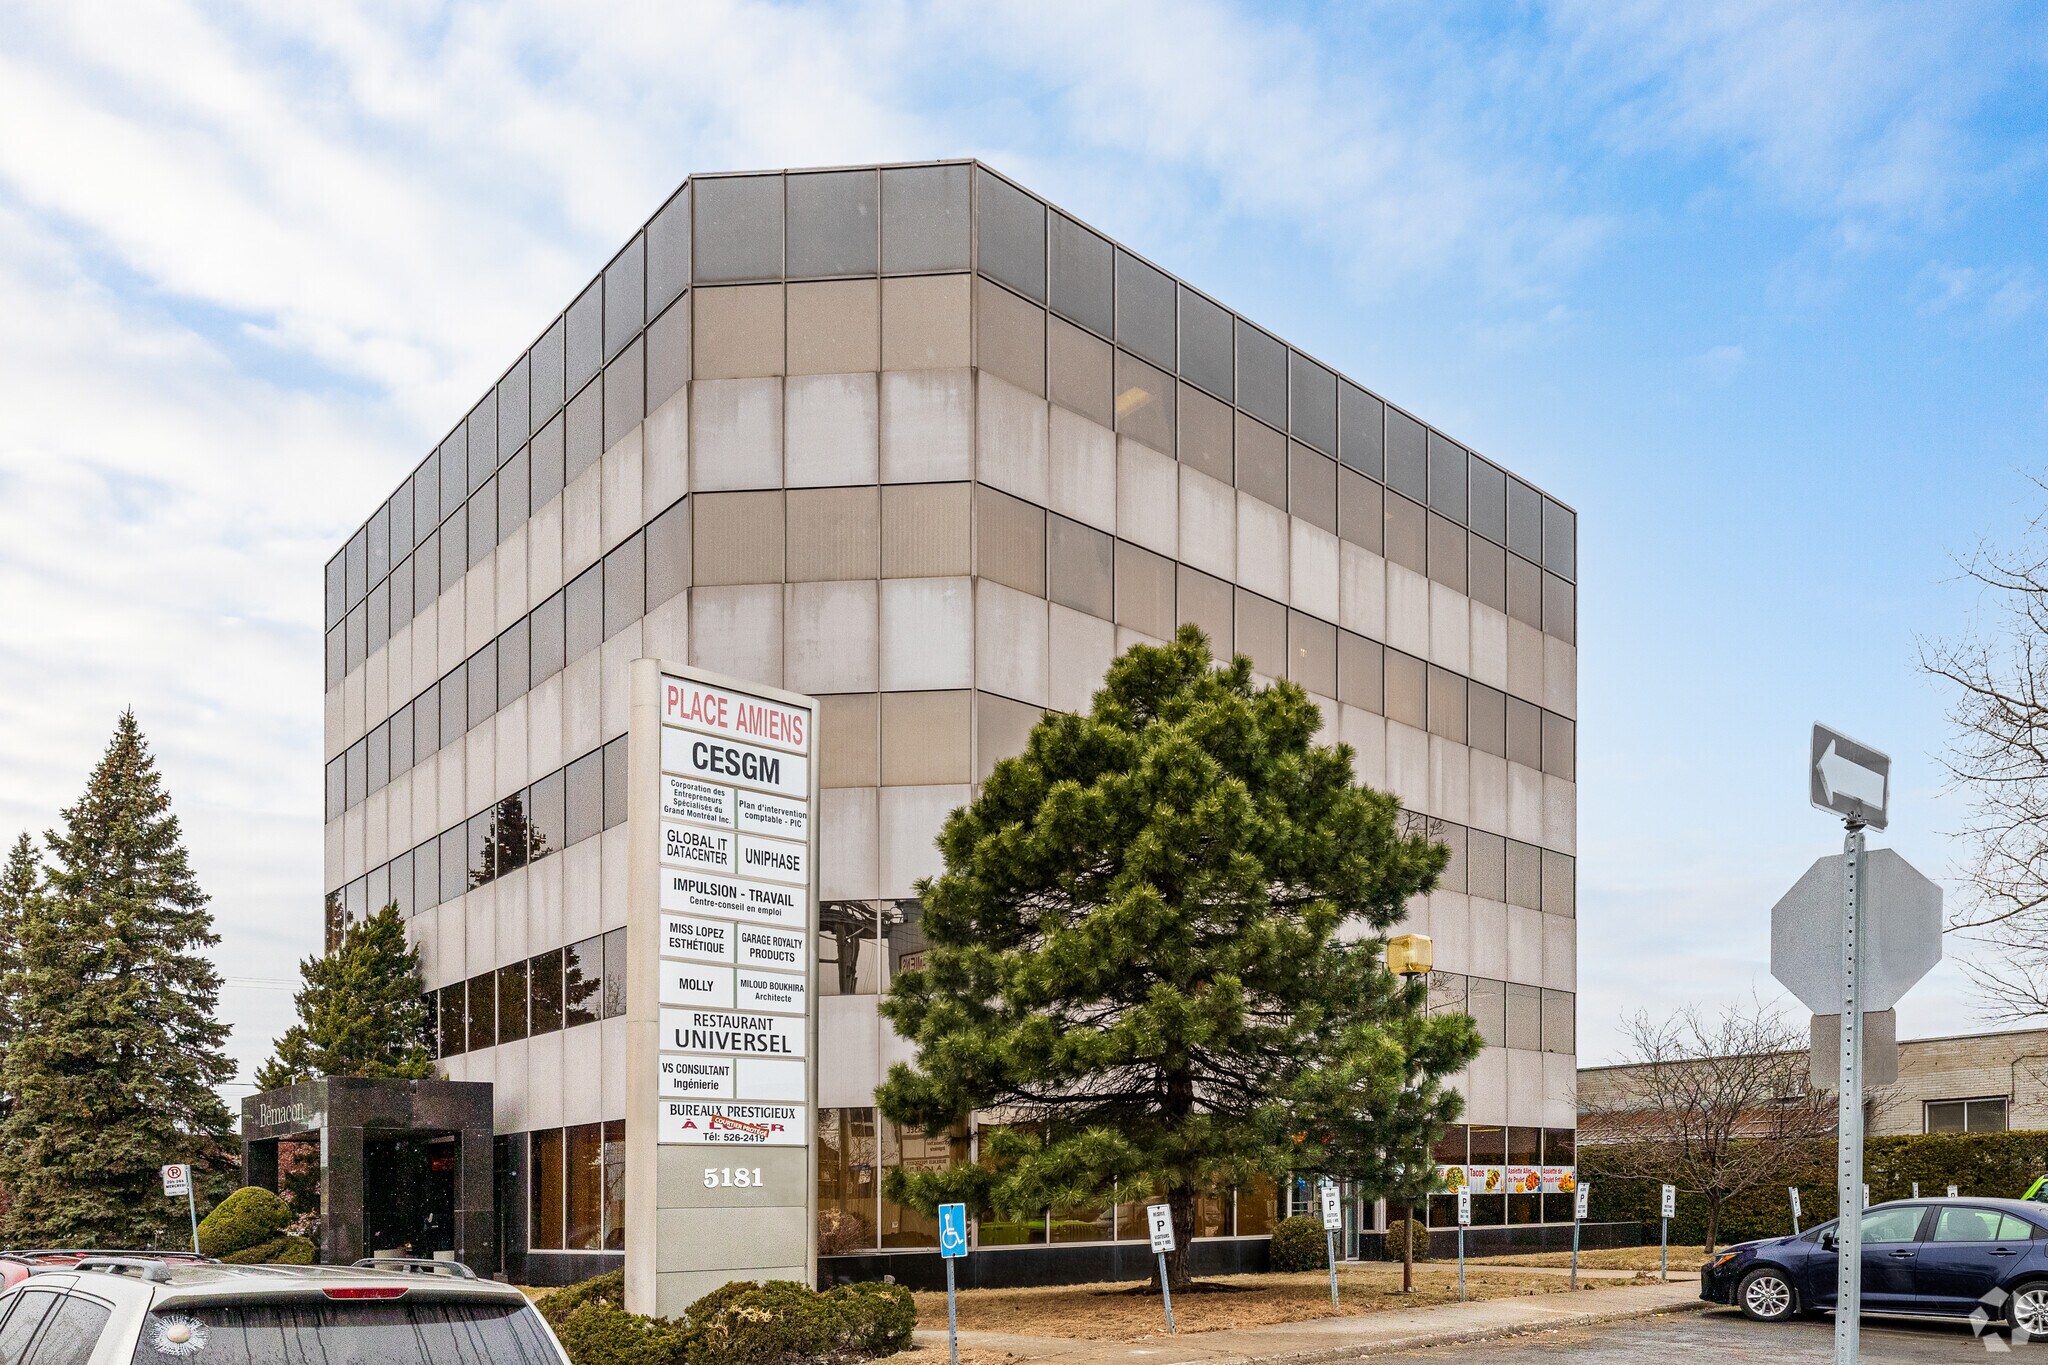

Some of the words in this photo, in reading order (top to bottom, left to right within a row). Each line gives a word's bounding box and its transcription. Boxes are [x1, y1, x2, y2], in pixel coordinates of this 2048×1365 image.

[668, 685, 728, 728] PLACE
[736, 703, 803, 745] AMIENS
[692, 741, 780, 785] CESGM
[670, 780, 711, 794] Corporation
[713, 787, 725, 796] des
[674, 789, 722, 805] Entrepreneurs
[673, 798, 712, 813] Spécialisés
[714, 805, 723, 814] du
[739, 800, 755, 810] Plan
[758, 803, 807, 819] d'intervention
[664, 805, 684, 817] Grand
[686, 810, 717, 823] Montréal
[719, 816, 731, 824] Inc.
[745, 812, 782, 825] comptable
[790, 817, 802, 828] PIC
[667, 829, 714, 849] GLOBAL
[717, 838, 727, 851] IT
[667, 844, 727, 865] DATACENTER
[745, 848, 800, 871] UNIPHASE
[674, 878, 737, 898] IMPULSION
[749, 889, 794, 907] TRAVAIL
[690, 896, 744, 911] Centre-conseil
[758, 907, 782, 917] emploi
[670, 923, 693, 935] MISS
[696, 926, 724, 939] LOPEZ
[669, 937, 724, 954] ESTHÉTIQUE
[742, 933, 771, 946] GARAGE
[773, 937, 802, 949] ROYALTY
[750, 948, 795, 962] PRODUCTS
[679, 978, 714, 992] MOLLY
[740, 979, 767, 990] MILOUD
[770, 982, 804, 992] BOUKHIRA
[755, 992, 792, 1003] Architecte
[694, 1014, 773, 1030] RESTAURANT
[675, 1028, 792, 1053] UNIVERSEL
[662, 1063, 674, 1073] VS
[676, 1063, 729, 1076] CONSULTANT
[674, 1078, 719, 1090] Ingénierie
[670, 1104, 722, 1117] BUREAUX
[728, 1106, 795, 1119] PRESTIGIEUX
[703, 1132, 720, 1141] Tél:
[724, 1134, 765, 1142] 526-2419
[703, 1168, 763, 1188] 5181
[1470, 1168, 1484, 1177] Tacos
[1329, 1200, 1335, 1210] P
[1463, 1198, 1467, 1207] P
[1580, 1193, 1585, 1202] P
[1666, 1195, 1671, 1203] P
[1157, 1220, 1165, 1231] P
